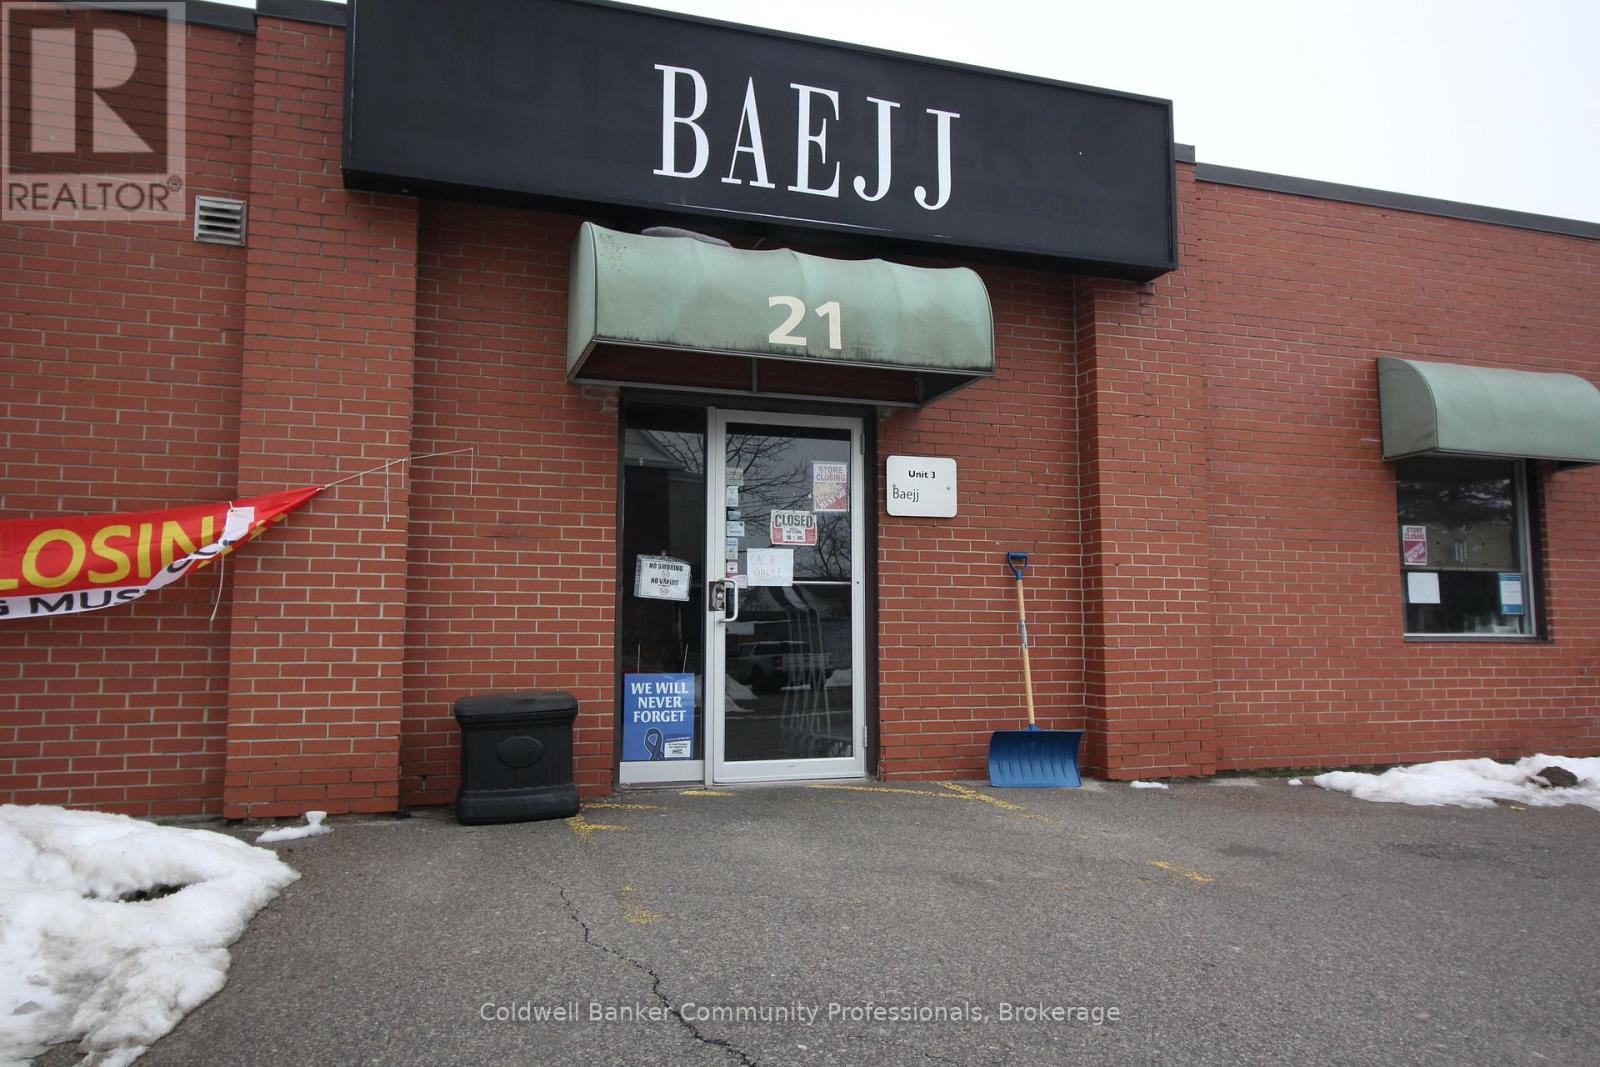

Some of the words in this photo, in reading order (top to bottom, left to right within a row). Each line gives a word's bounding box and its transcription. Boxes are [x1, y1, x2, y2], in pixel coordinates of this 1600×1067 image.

[653, 63, 960, 211] BAEJJ
[767, 295, 842, 350] 21
[908, 470, 928, 479] Unit
[931, 471, 936, 479] 3
[892, 487, 920, 502] Baejj
[774, 514, 813, 528] CLOSED
[631, 682, 653, 694] WE
[655, 682, 689, 694] WILL
[638, 696, 682, 708] NEVER
[633, 710, 687, 723] FORGET
